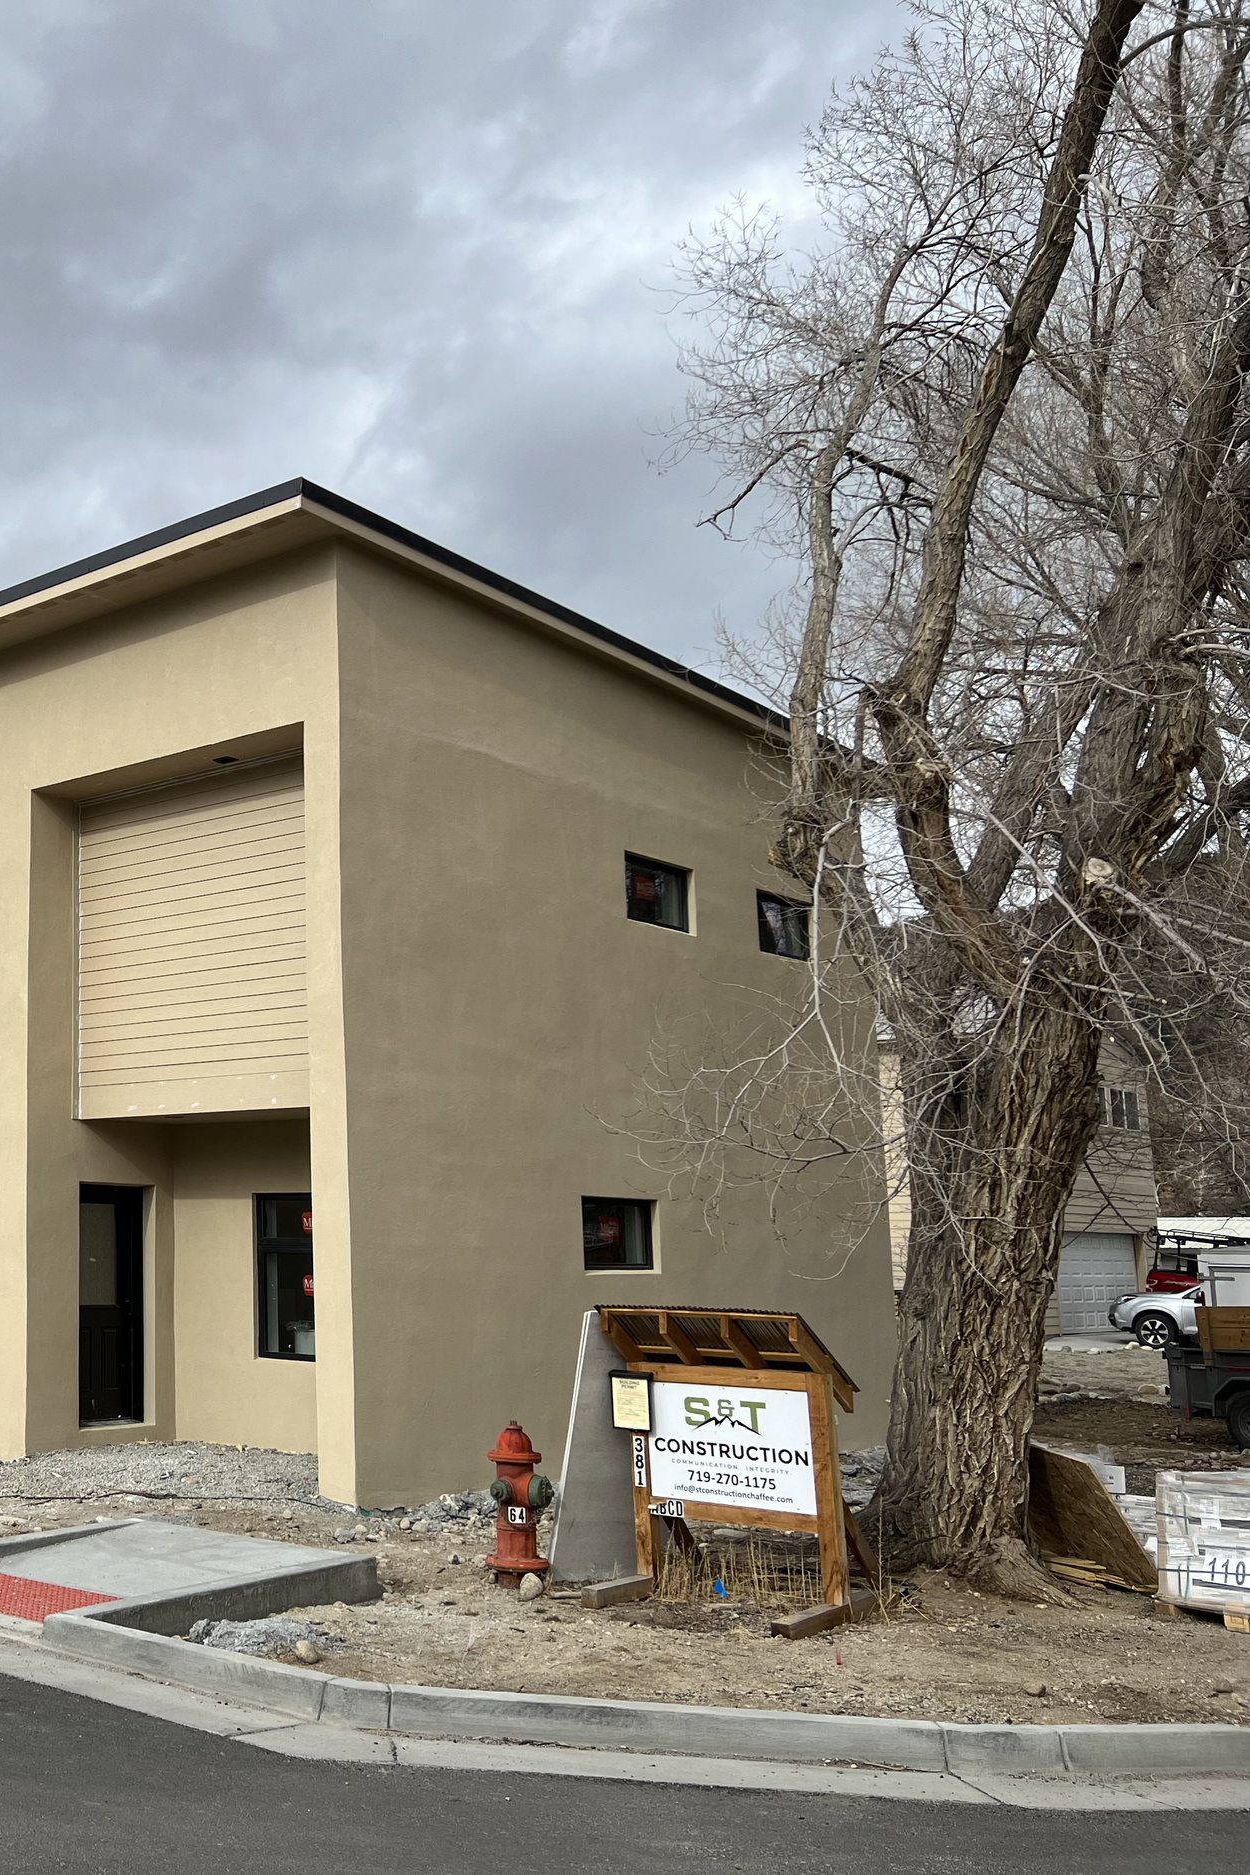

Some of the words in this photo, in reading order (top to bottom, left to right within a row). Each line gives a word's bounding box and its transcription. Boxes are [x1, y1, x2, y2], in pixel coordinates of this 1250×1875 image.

[634, 1437, 644, 1486] 381
[654, 1437, 810, 1466] CONSTRUCTION
[687, 1469, 776, 1490] 719-270-1175
[674, 1483, 794, 1504] info@stconstructionchaffee.com
[510, 1508, 525, 1522] 64
[1208, 1557, 1246, 1586] 110
